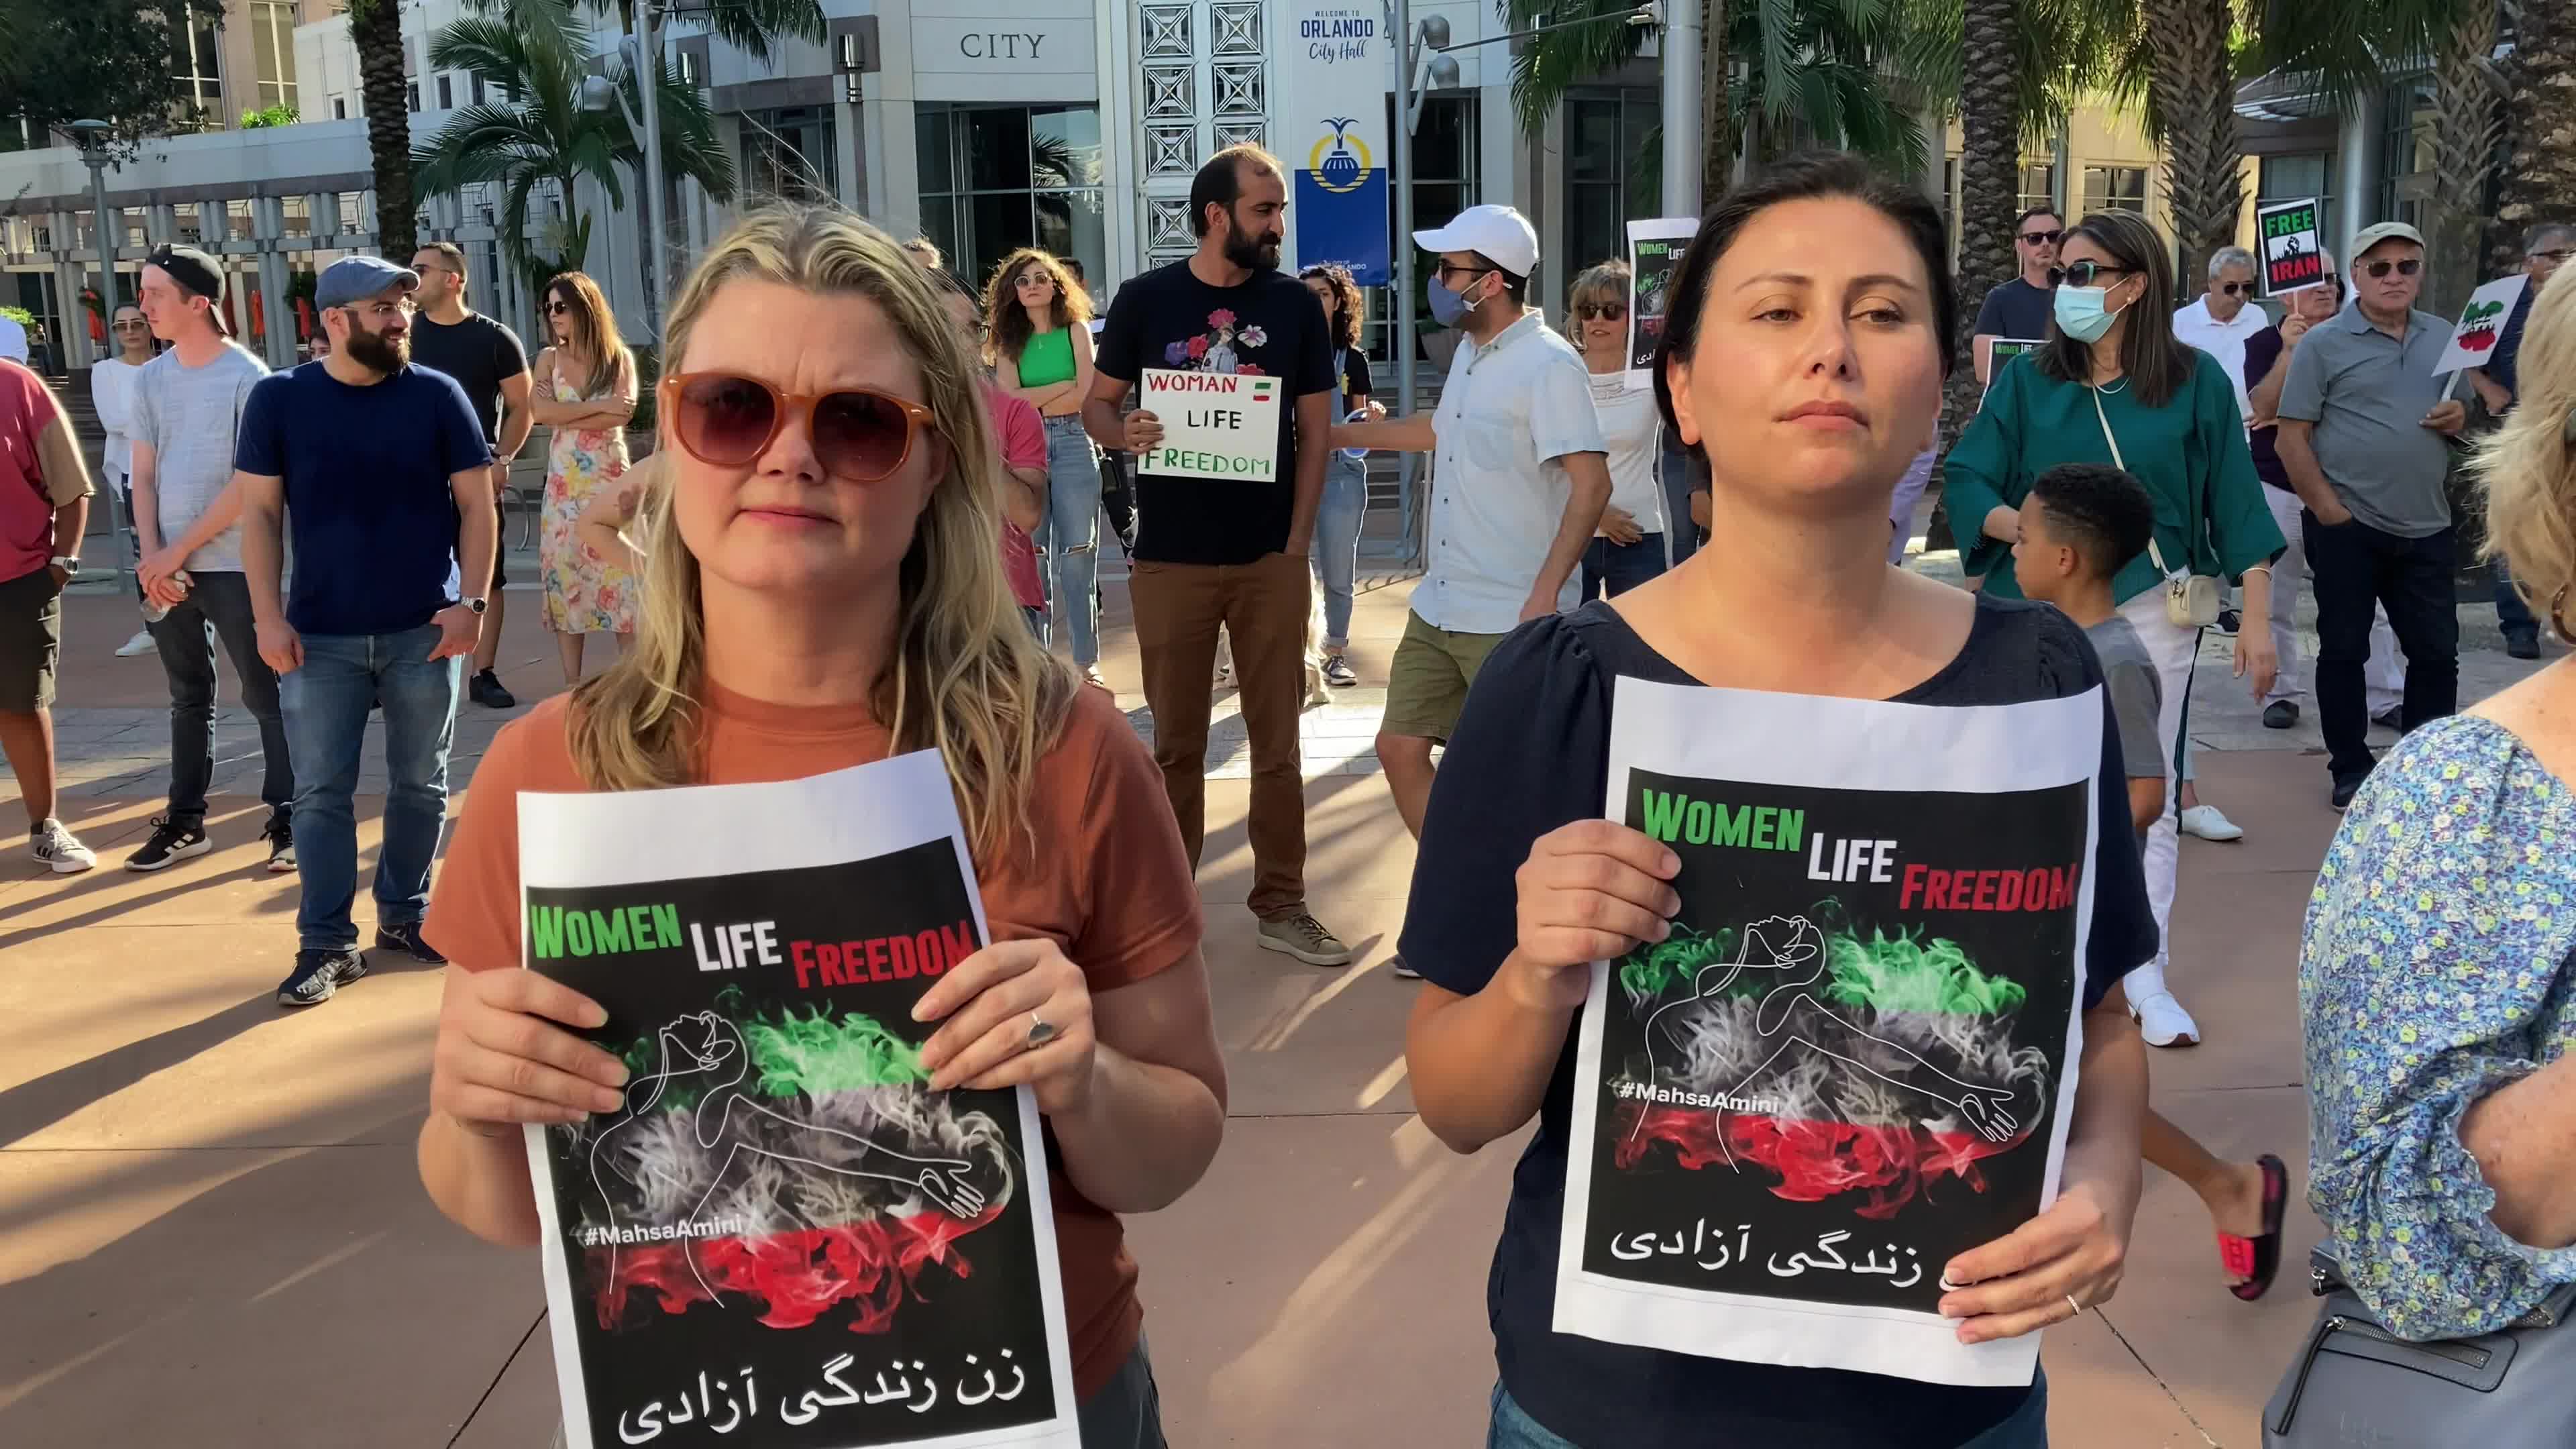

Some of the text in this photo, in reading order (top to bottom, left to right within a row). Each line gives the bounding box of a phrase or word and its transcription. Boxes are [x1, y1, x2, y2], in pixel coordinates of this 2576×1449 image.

[1301, 19, 1374, 38] ORLANDO
[960, 34, 1046, 58] CITY
[1309, 38, 1367, 64] City Hall
[2265, 209, 2314, 237] FREE
[1637, 242, 1668, 256] WOMEN
[2271, 255, 2319, 282] IRAN
[1147, 373, 1238, 393] WOMAN
[1187, 410, 1242, 429] LIFE
[1144, 447, 1270, 474] FREEDOM
[1643, 788, 2077, 912] WOMEN LIFE FREEDOM
[531, 903, 975, 988] WOMEN LIFE FREEDOM
[1619, 1081, 1779, 1113] #MahsaAmini
[584, 1214, 743, 1246] #MahsaAmini
[1610, 1218, 1752, 1271] آزادی
[1768, 1230, 1923, 1288] زندگی
[619, 1348, 1025, 1445] زن زندگی آزادی
